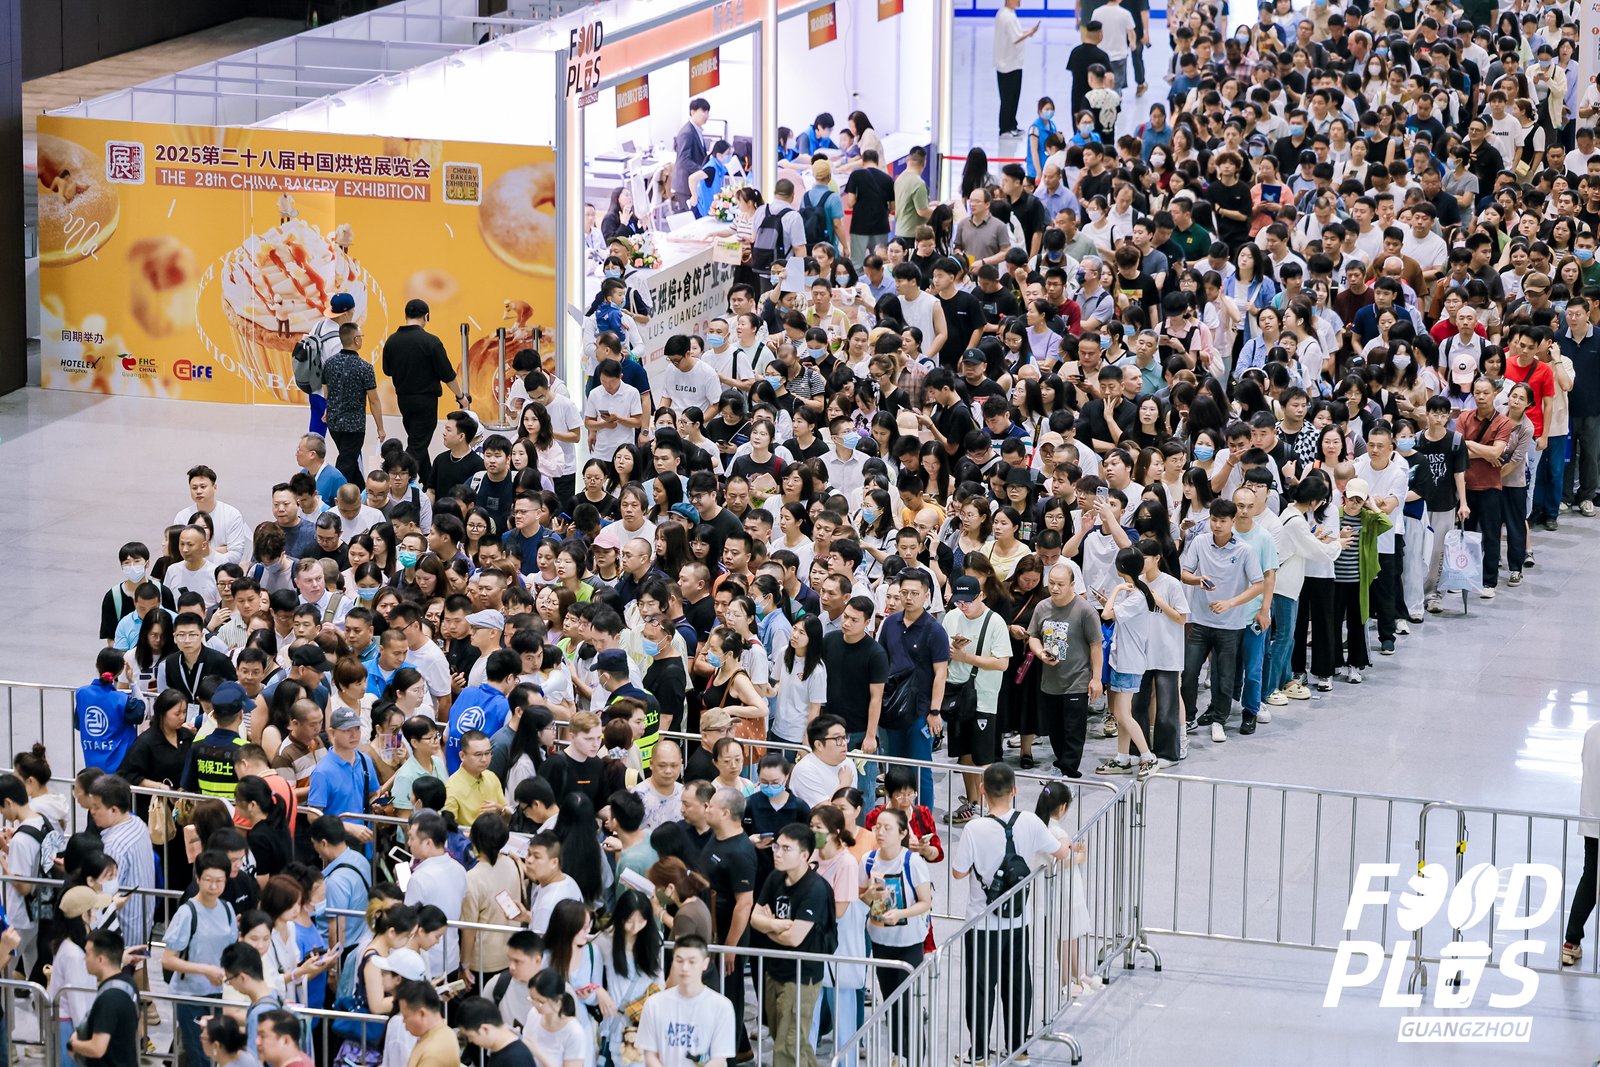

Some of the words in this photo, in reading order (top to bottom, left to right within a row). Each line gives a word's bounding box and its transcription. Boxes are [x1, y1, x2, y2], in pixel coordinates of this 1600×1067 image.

[155, 145, 431, 178] 2025第二十八届中国烘焙展览会
[450, 173, 477, 181] BAKERY
[161, 169, 186, 185] THE
[195, 171, 226, 187] 28th
[230, 174, 278, 190] CHINA
[284, 177, 339, 193] BAKERY
[344, 181, 426, 200] EXHIBITION
[648, 320, 665, 340] LUS
[668, 293, 720, 330] GUANGZHOU
[61, 329, 105, 345] 同期举办
[60, 356, 102, 369] HOTELEX
[138, 358, 156, 366] FHC
[82, 739, 114, 751] STAFF
